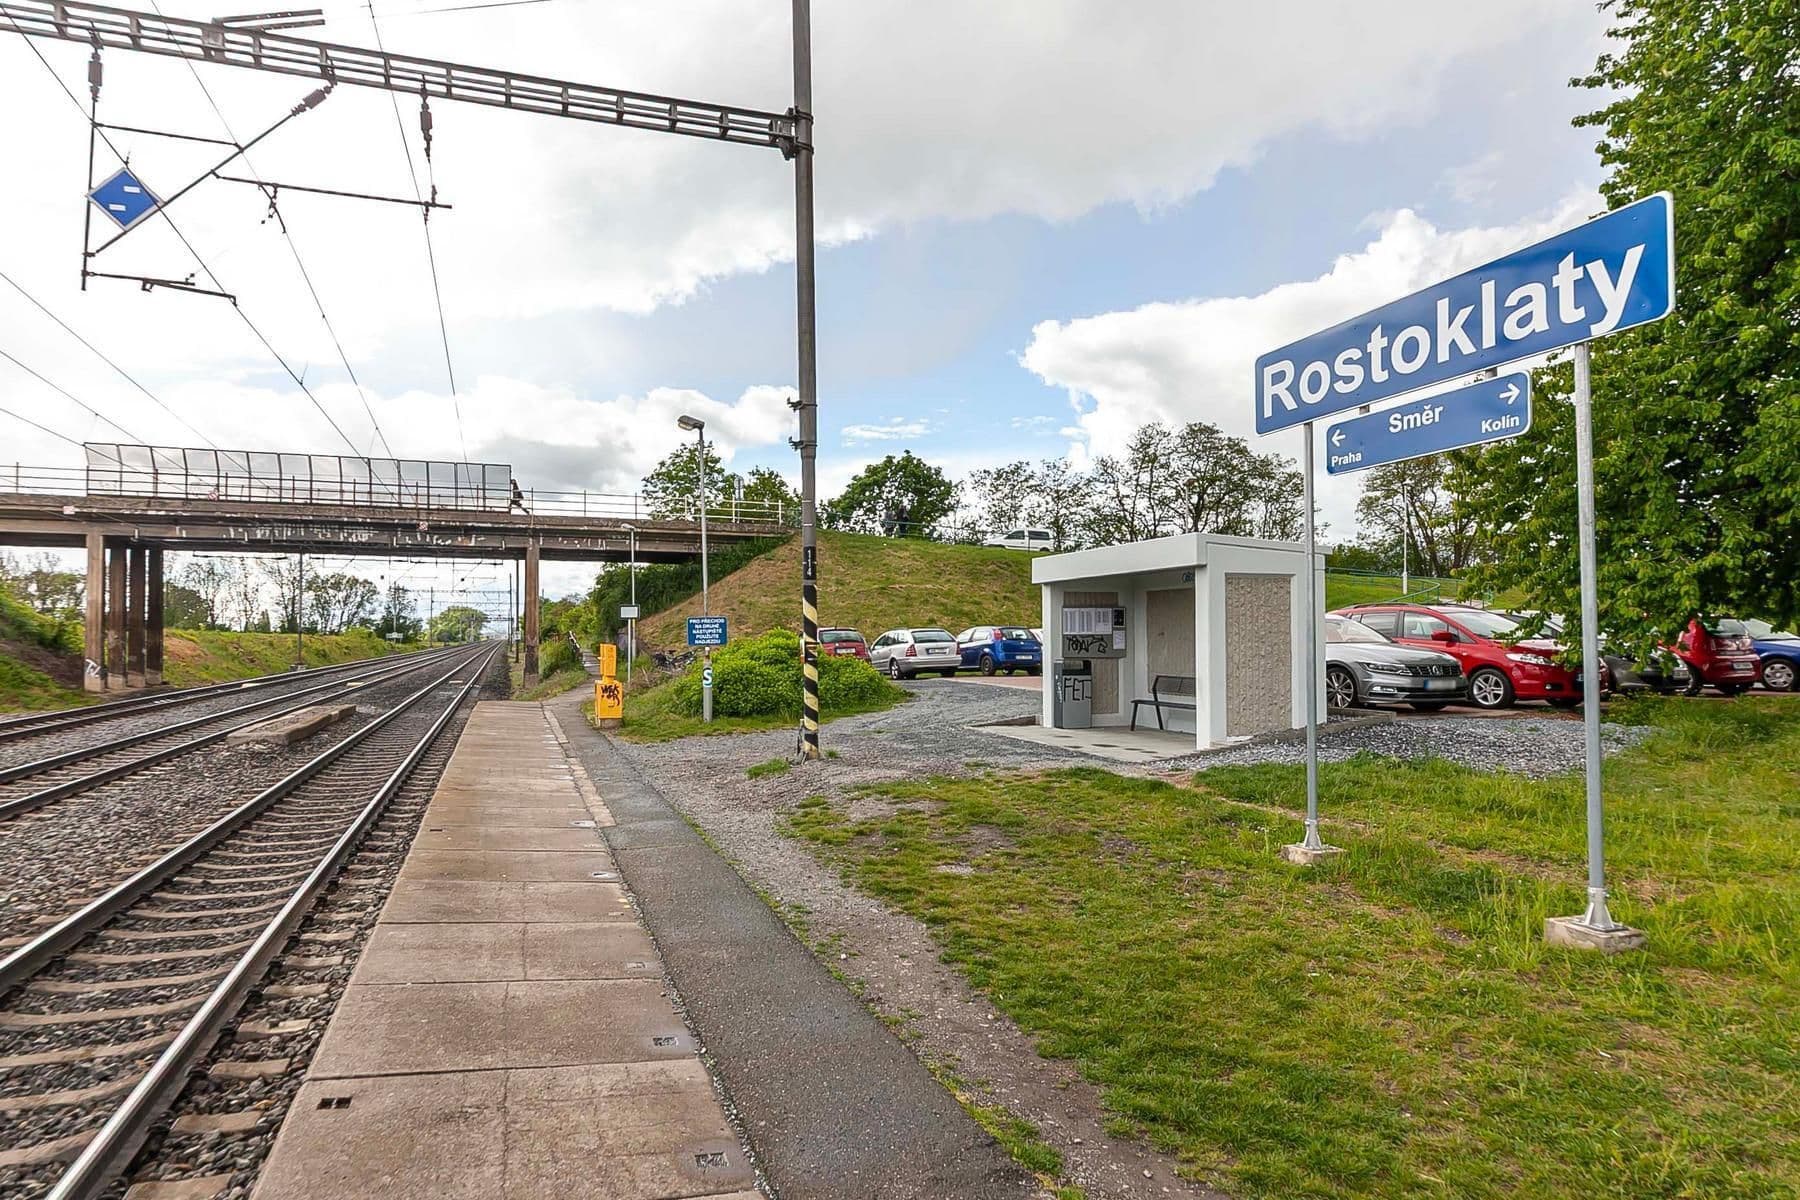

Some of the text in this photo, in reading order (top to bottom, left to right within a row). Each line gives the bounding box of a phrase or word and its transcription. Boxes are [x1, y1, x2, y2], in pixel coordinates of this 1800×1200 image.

[1263, 243, 1646, 419] Rostoklaty
[1389, 404, 1444, 434] Směr
[1481, 414, 1520, 434] Kolín
[1331, 451, 1362, 467] Praha
